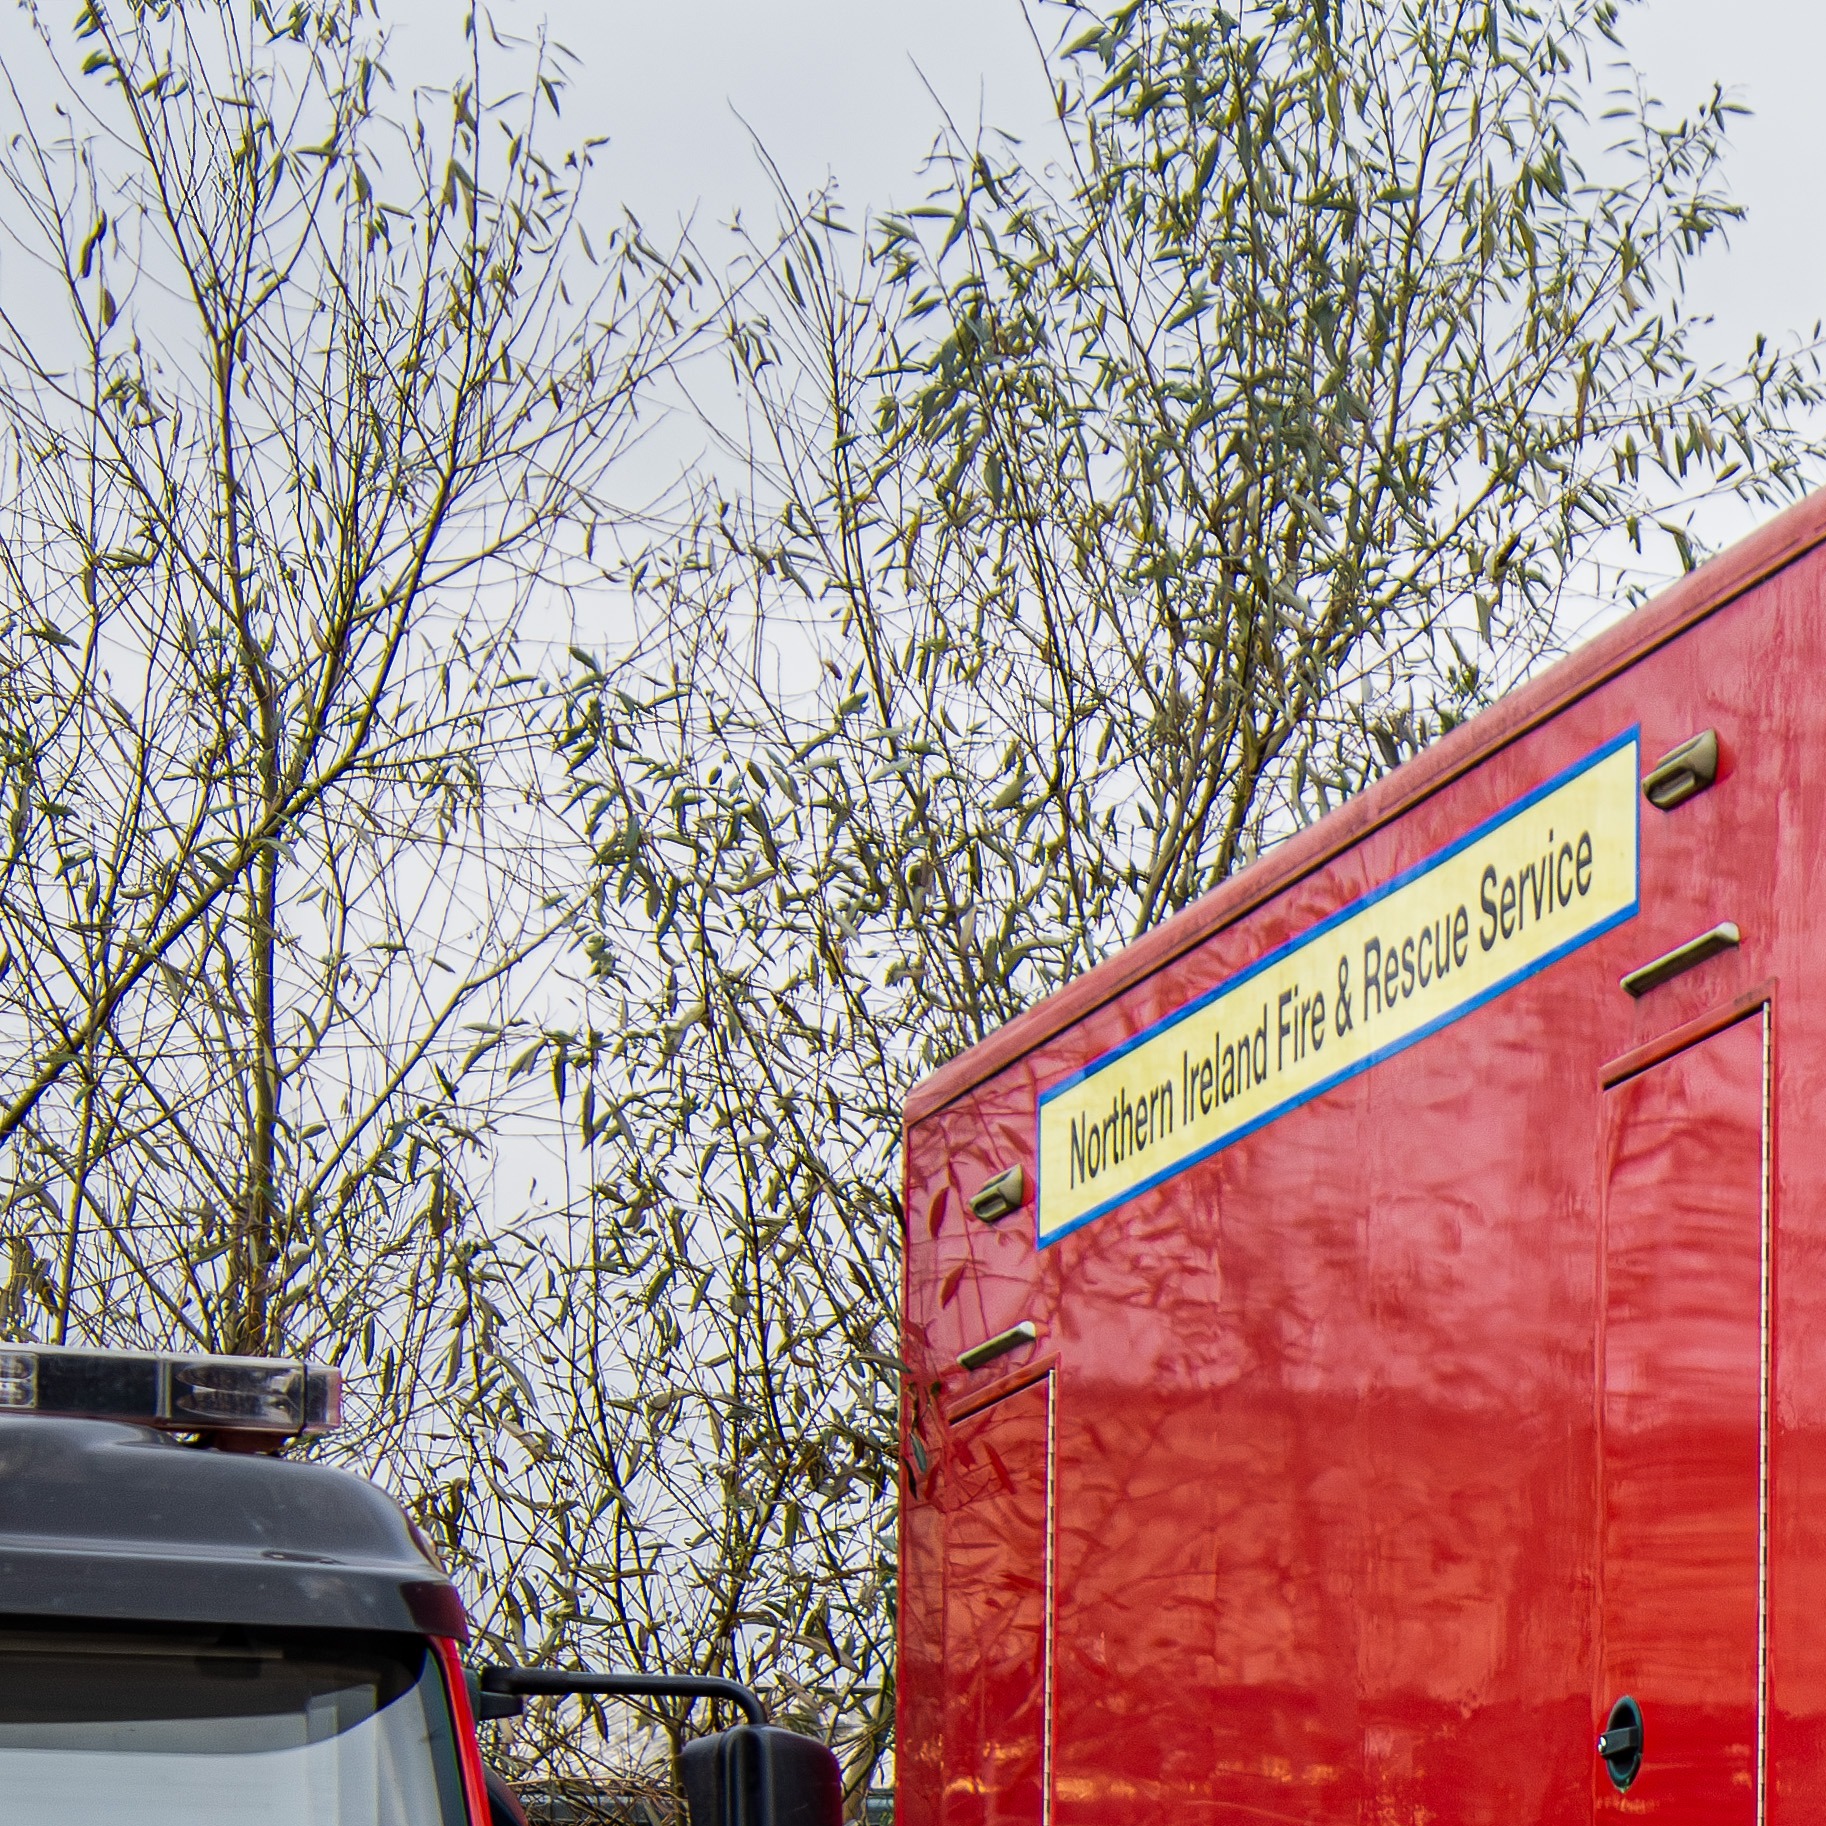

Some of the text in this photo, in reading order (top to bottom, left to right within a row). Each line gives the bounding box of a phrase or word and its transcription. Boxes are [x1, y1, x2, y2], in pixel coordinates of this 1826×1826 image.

[1069, 829, 1594, 1189] Northern Ireland Fire & Rescue Service
